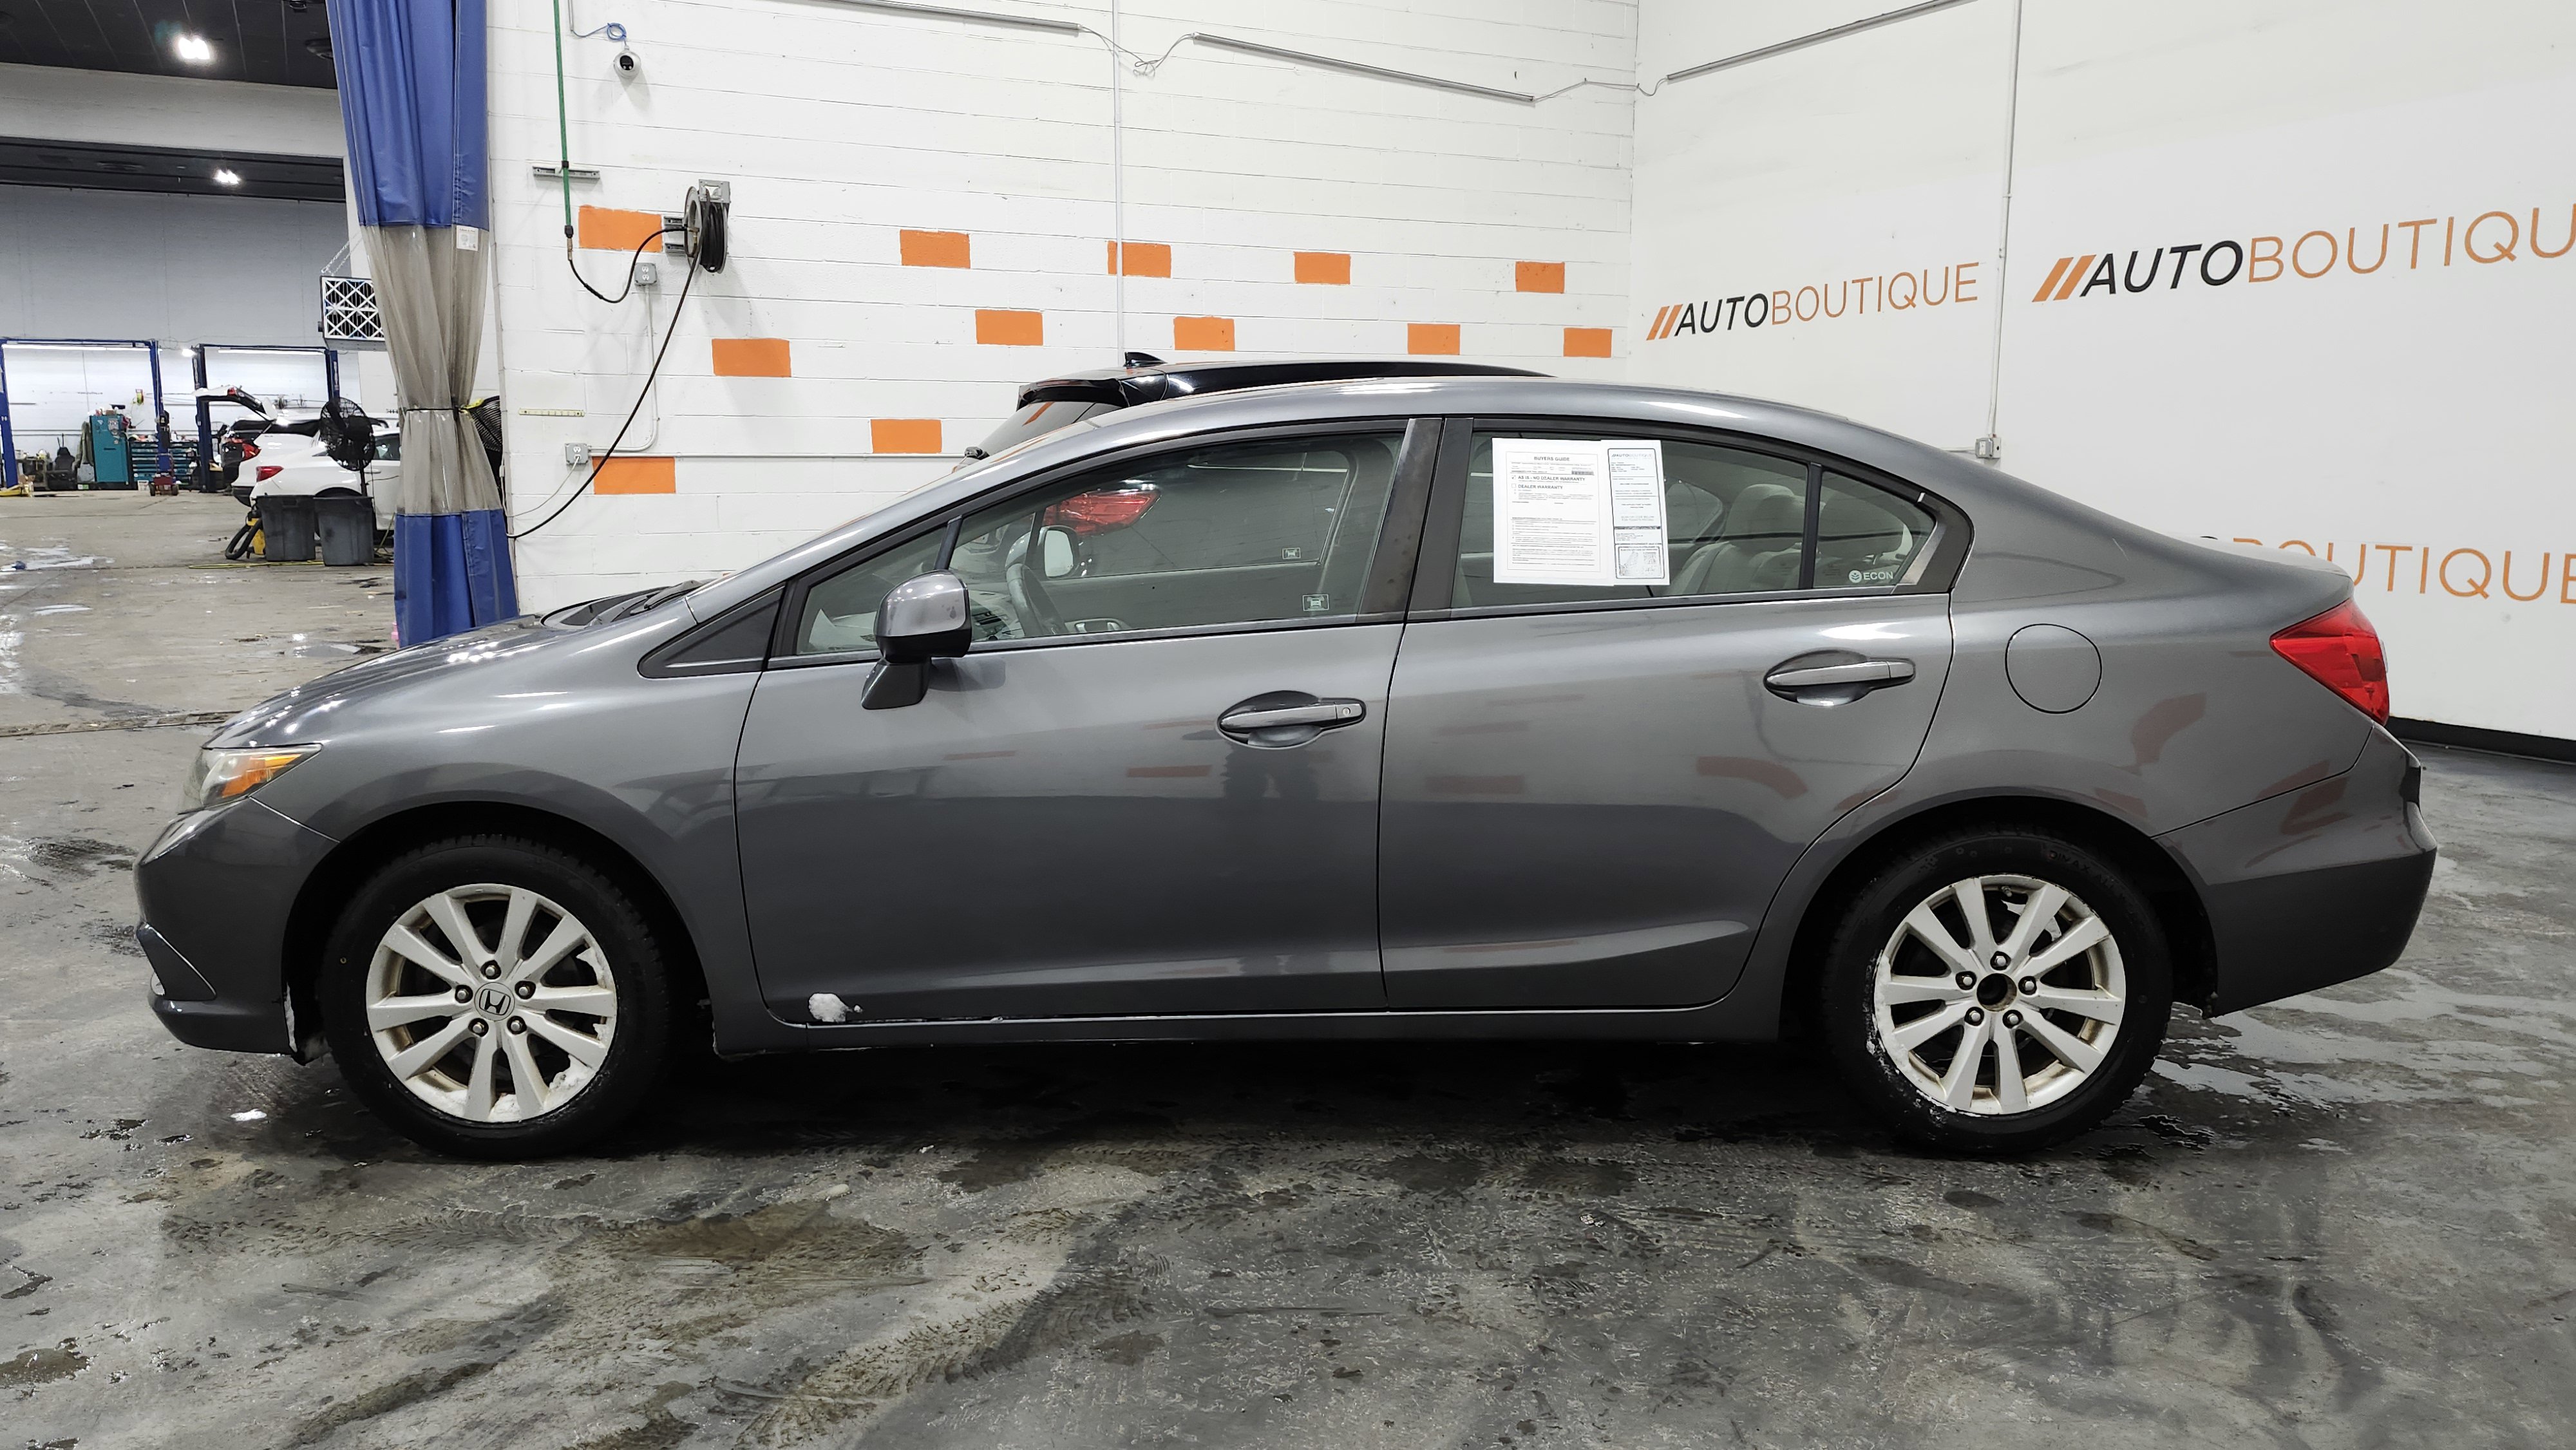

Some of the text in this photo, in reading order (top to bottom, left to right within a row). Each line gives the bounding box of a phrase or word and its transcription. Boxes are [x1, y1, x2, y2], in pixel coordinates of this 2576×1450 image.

[1674, 262, 1980, 337] AUTOBOUTIQUE
[1862, 571, 1893, 580] ECON
[2231, 537, 2576, 605] UTIQUE
